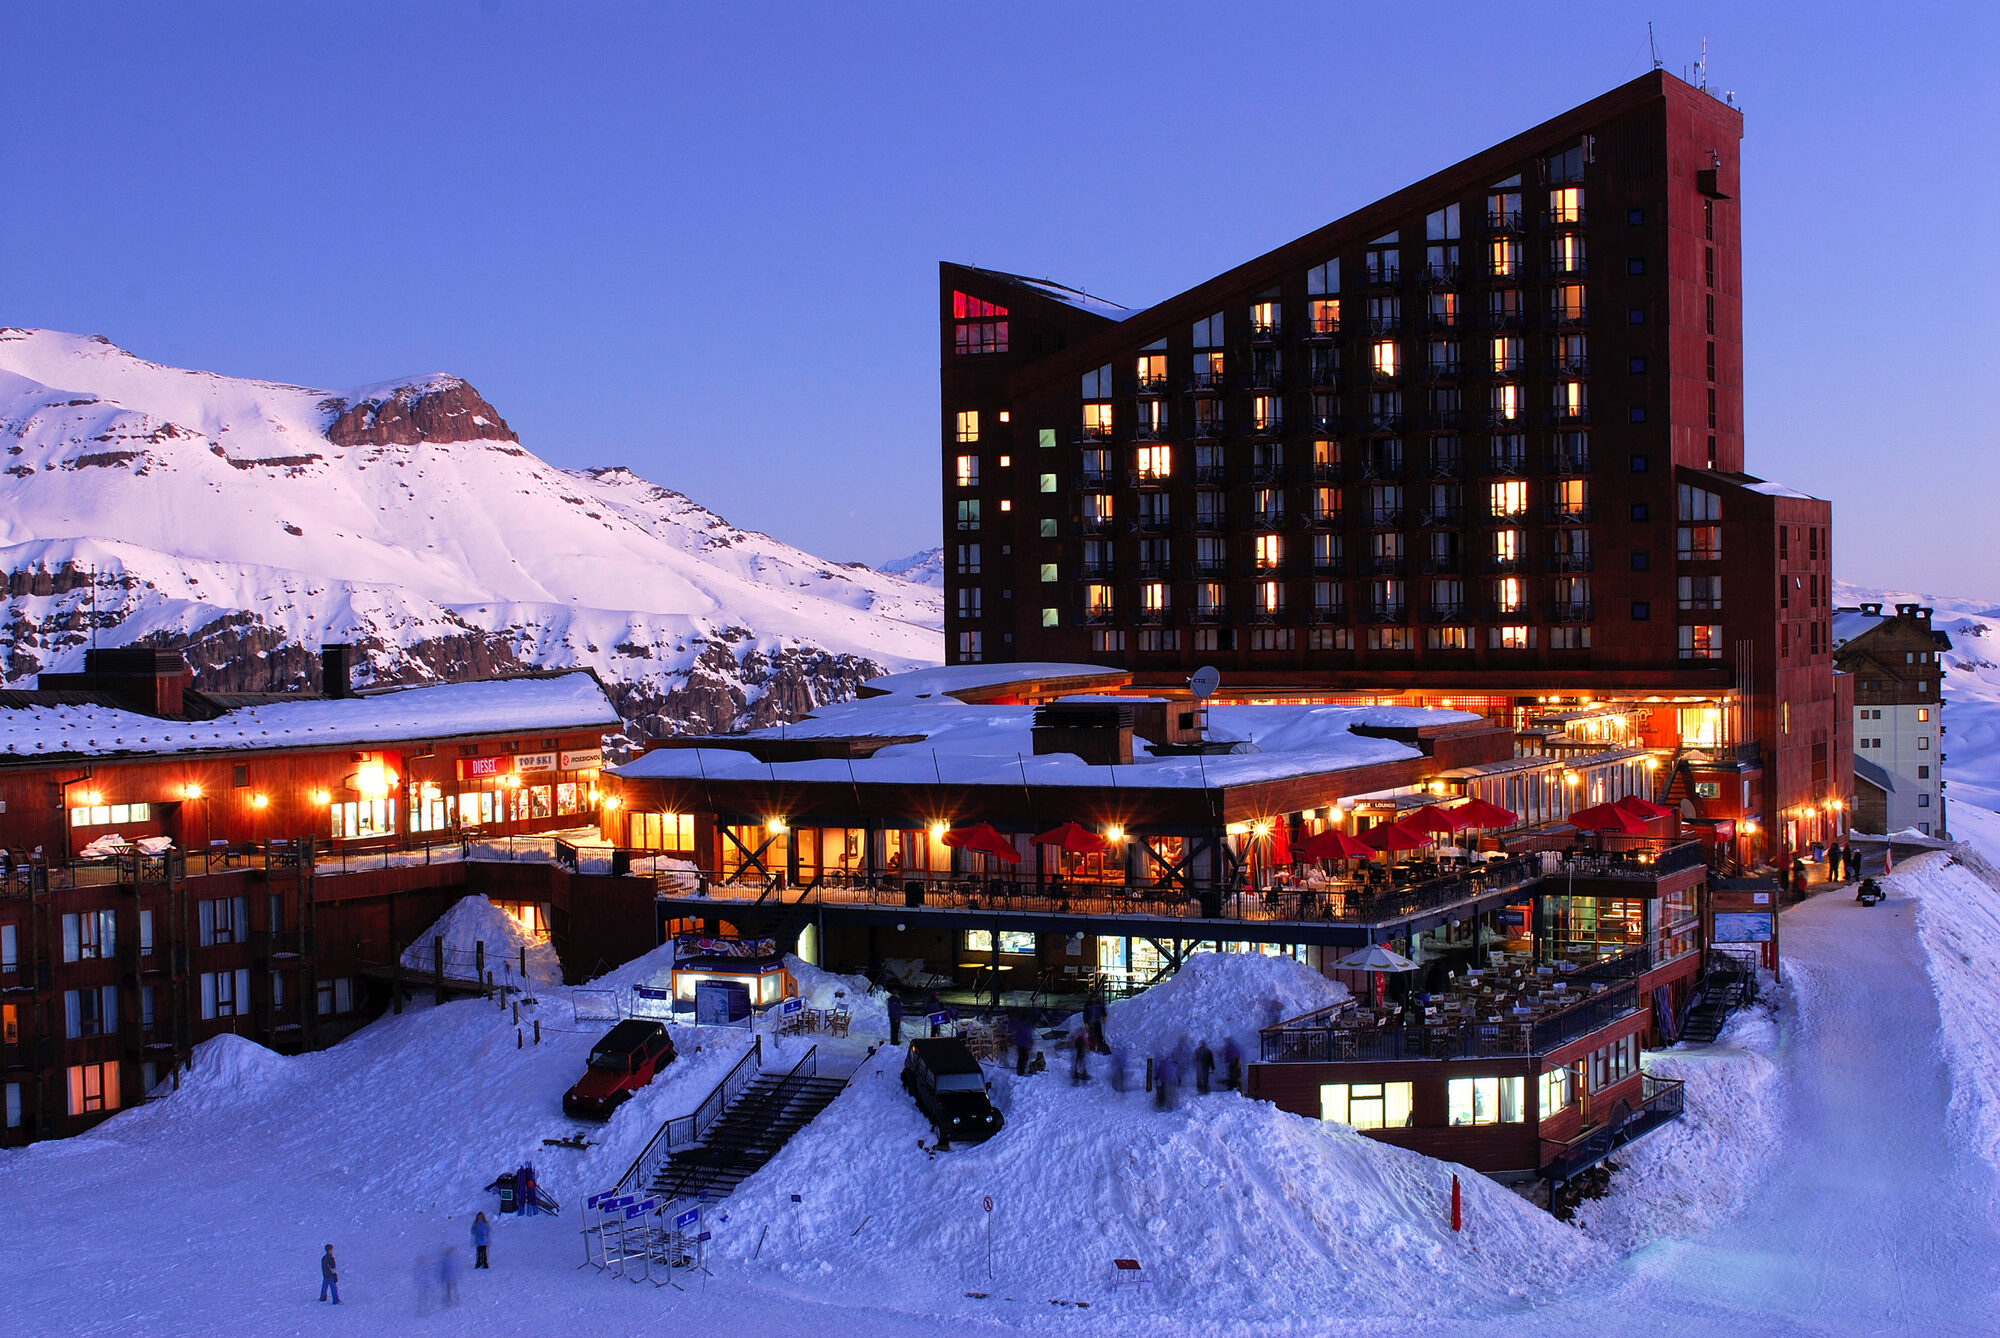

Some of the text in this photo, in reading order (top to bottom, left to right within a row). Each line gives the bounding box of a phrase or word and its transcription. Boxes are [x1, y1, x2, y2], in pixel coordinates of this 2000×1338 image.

[518, 755, 552, 766] TOP SKI
[570, 754, 601, 763] ROSSIGNOL
[472, 759, 497, 774] DIESEL
